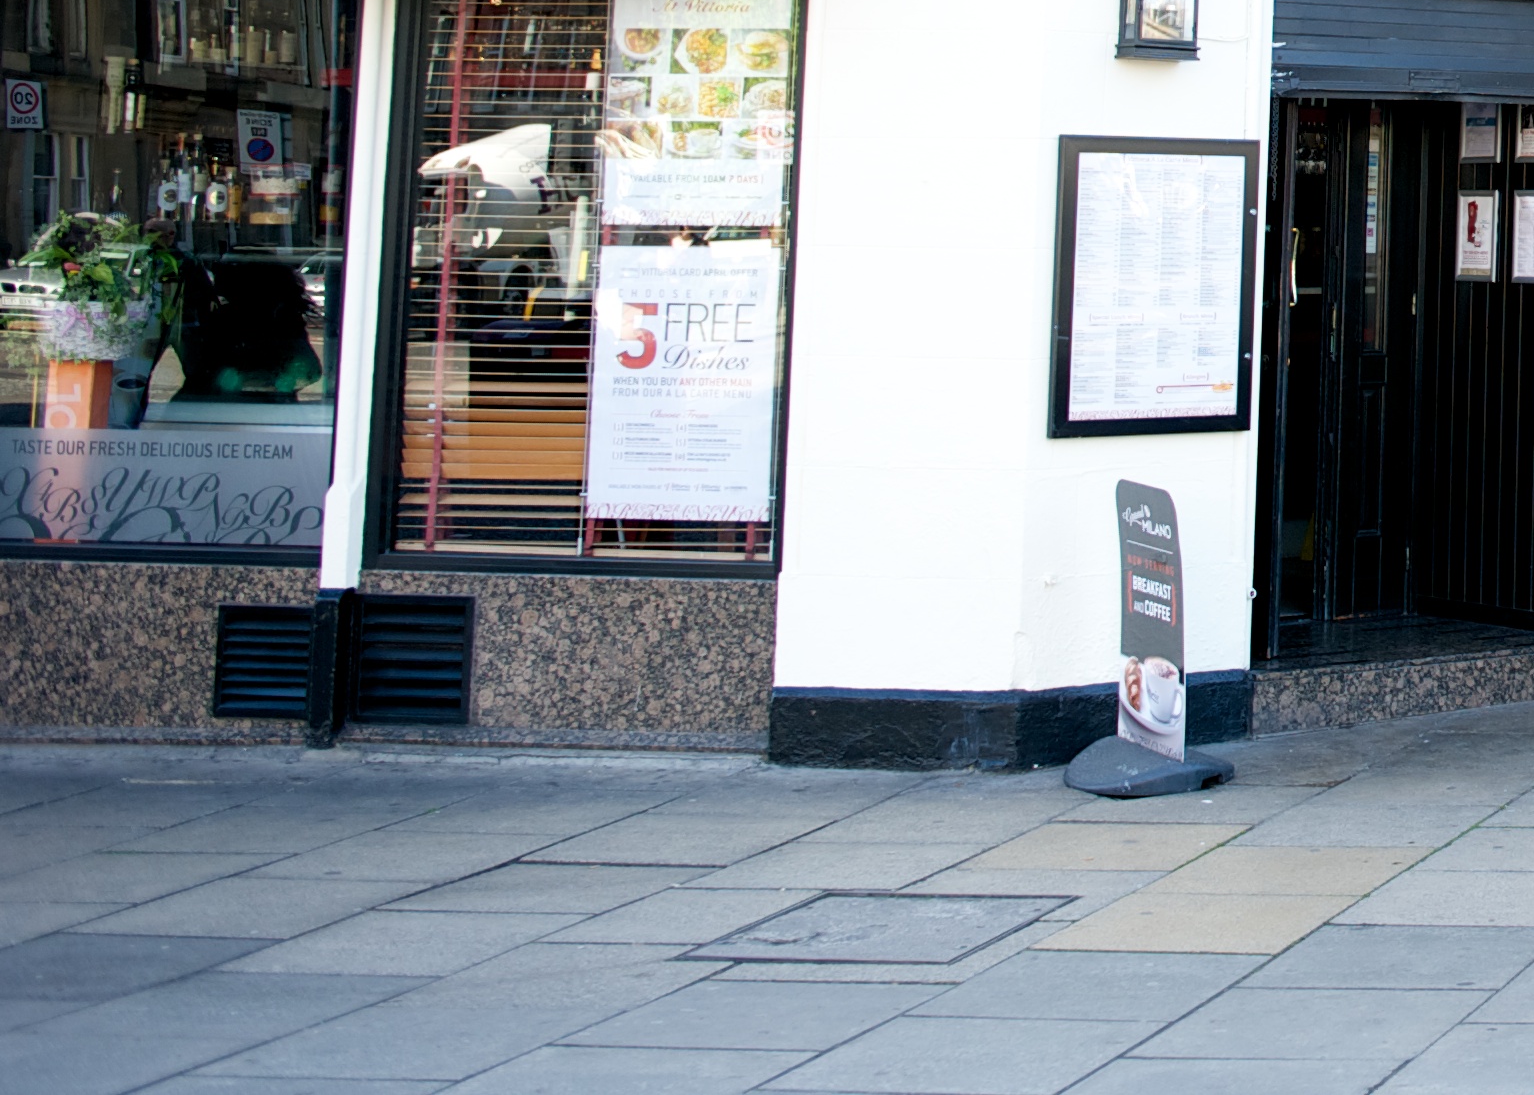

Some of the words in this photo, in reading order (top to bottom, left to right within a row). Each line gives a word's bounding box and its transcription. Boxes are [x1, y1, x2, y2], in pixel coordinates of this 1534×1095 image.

[630, 174, 673, 183] VAILABLE
[616, 303, 658, 369] 5
[664, 303, 756, 343] FREE
[662, 344, 749, 370] Dishes
[613, 377, 639, 386] WHEN
[641, 377, 658, 386] YOU
[660, 377, 678, 386] BUY
[679, 377, 697, 386] ANY
[699, 378, 727, 387] OTHER
[730, 378, 752, 387] MAIN
[612, 388, 639, 396] FROM
[643, 388, 662, 397] OUR
[666, 389, 671, 397] A
[675, 389, 686, 398] LA
[690, 389, 719, 398] CARTE
[724, 390, 752, 398] MENU
[12, 439, 52, 455] TASTE
[56, 440, 85, 455] OUR
[89, 441, 136, 456] FRESH
[140, 442, 213, 458] DELICIOUS
[217, 443, 239, 459] ICE
[243, 444, 293, 459] CREAM
[1142, 519, 1171, 540] MILANO
[1132, 574, 1171, 601] BREAKFAST
[1144, 600, 1171, 622] COFFEE
